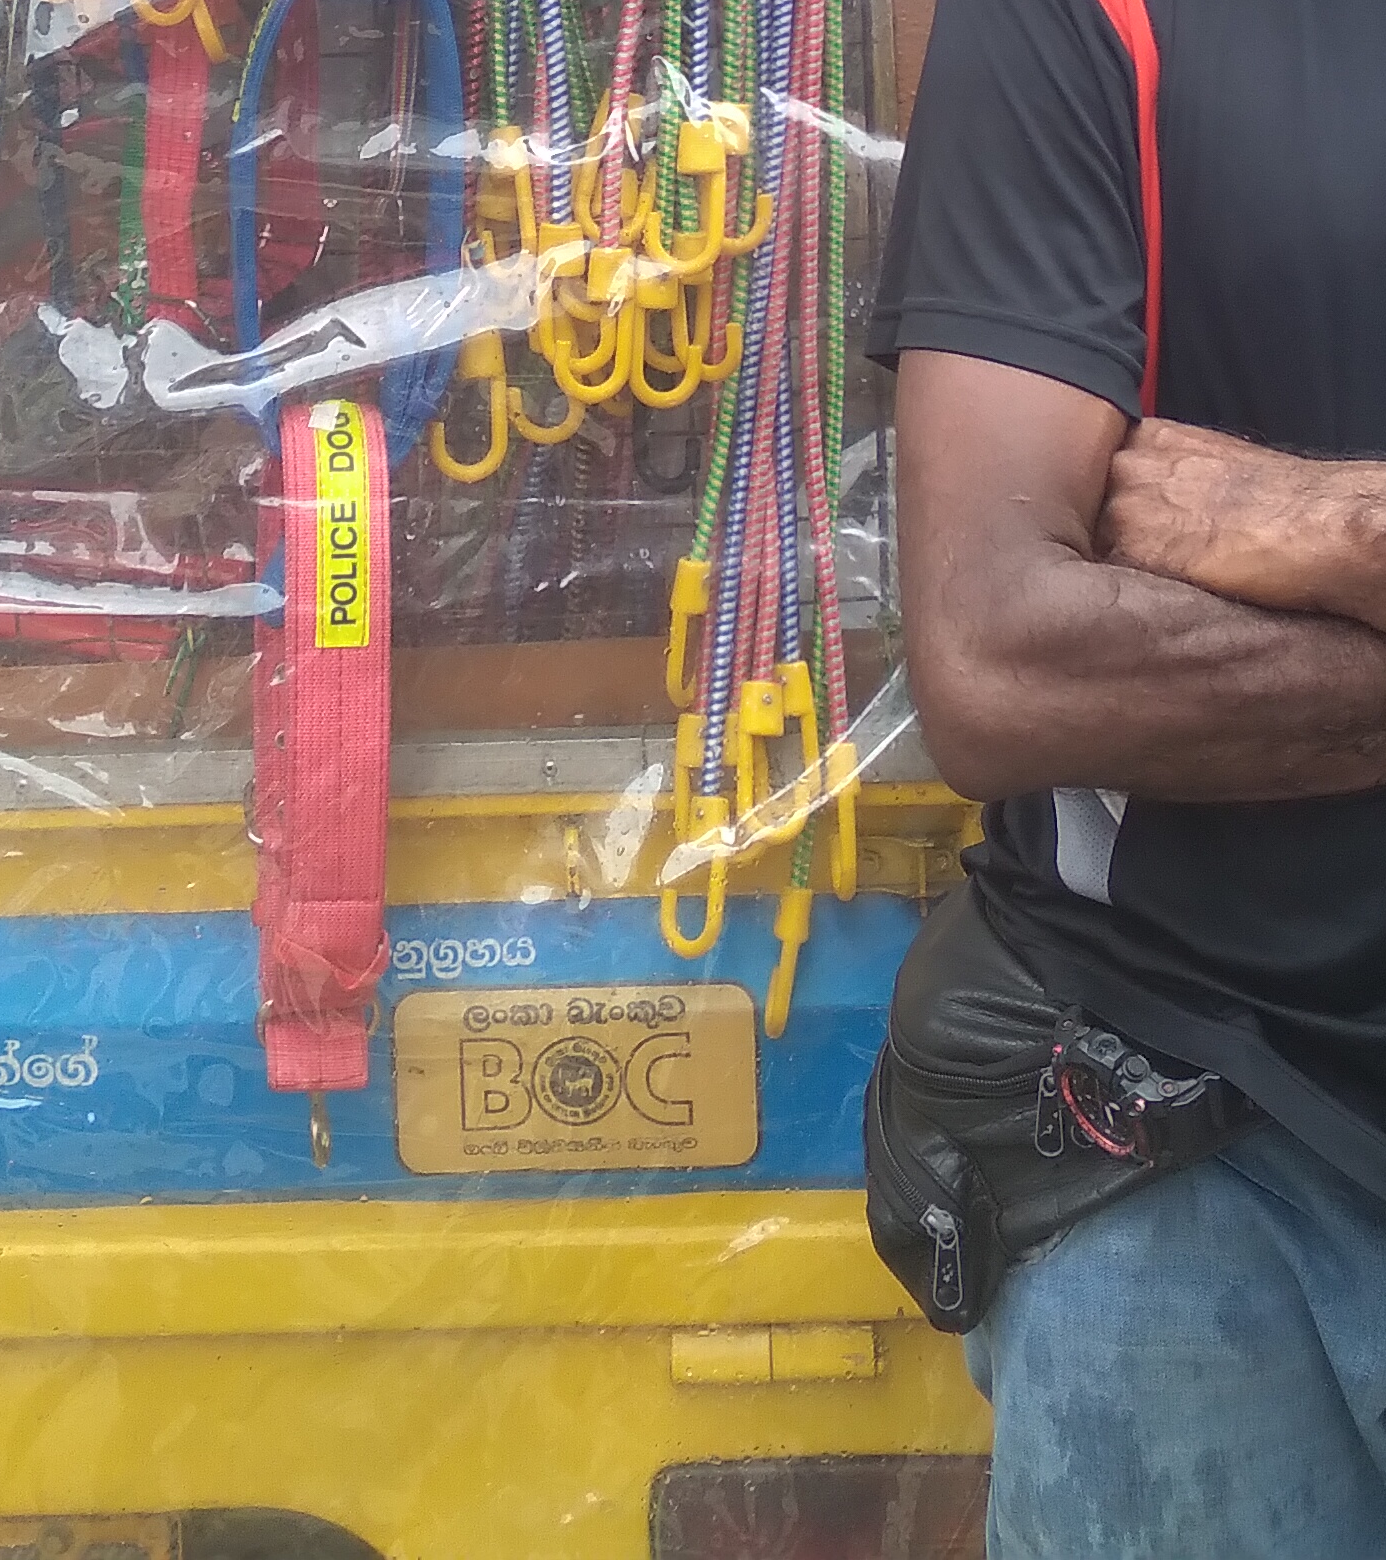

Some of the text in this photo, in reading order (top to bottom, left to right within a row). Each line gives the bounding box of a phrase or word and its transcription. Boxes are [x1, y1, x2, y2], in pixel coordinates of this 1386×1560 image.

[329, 500, 359, 626] POLICE
[389, 936, 537, 981] නුග්‍රහය
[463, 1002, 554, 1033] ලංකා
